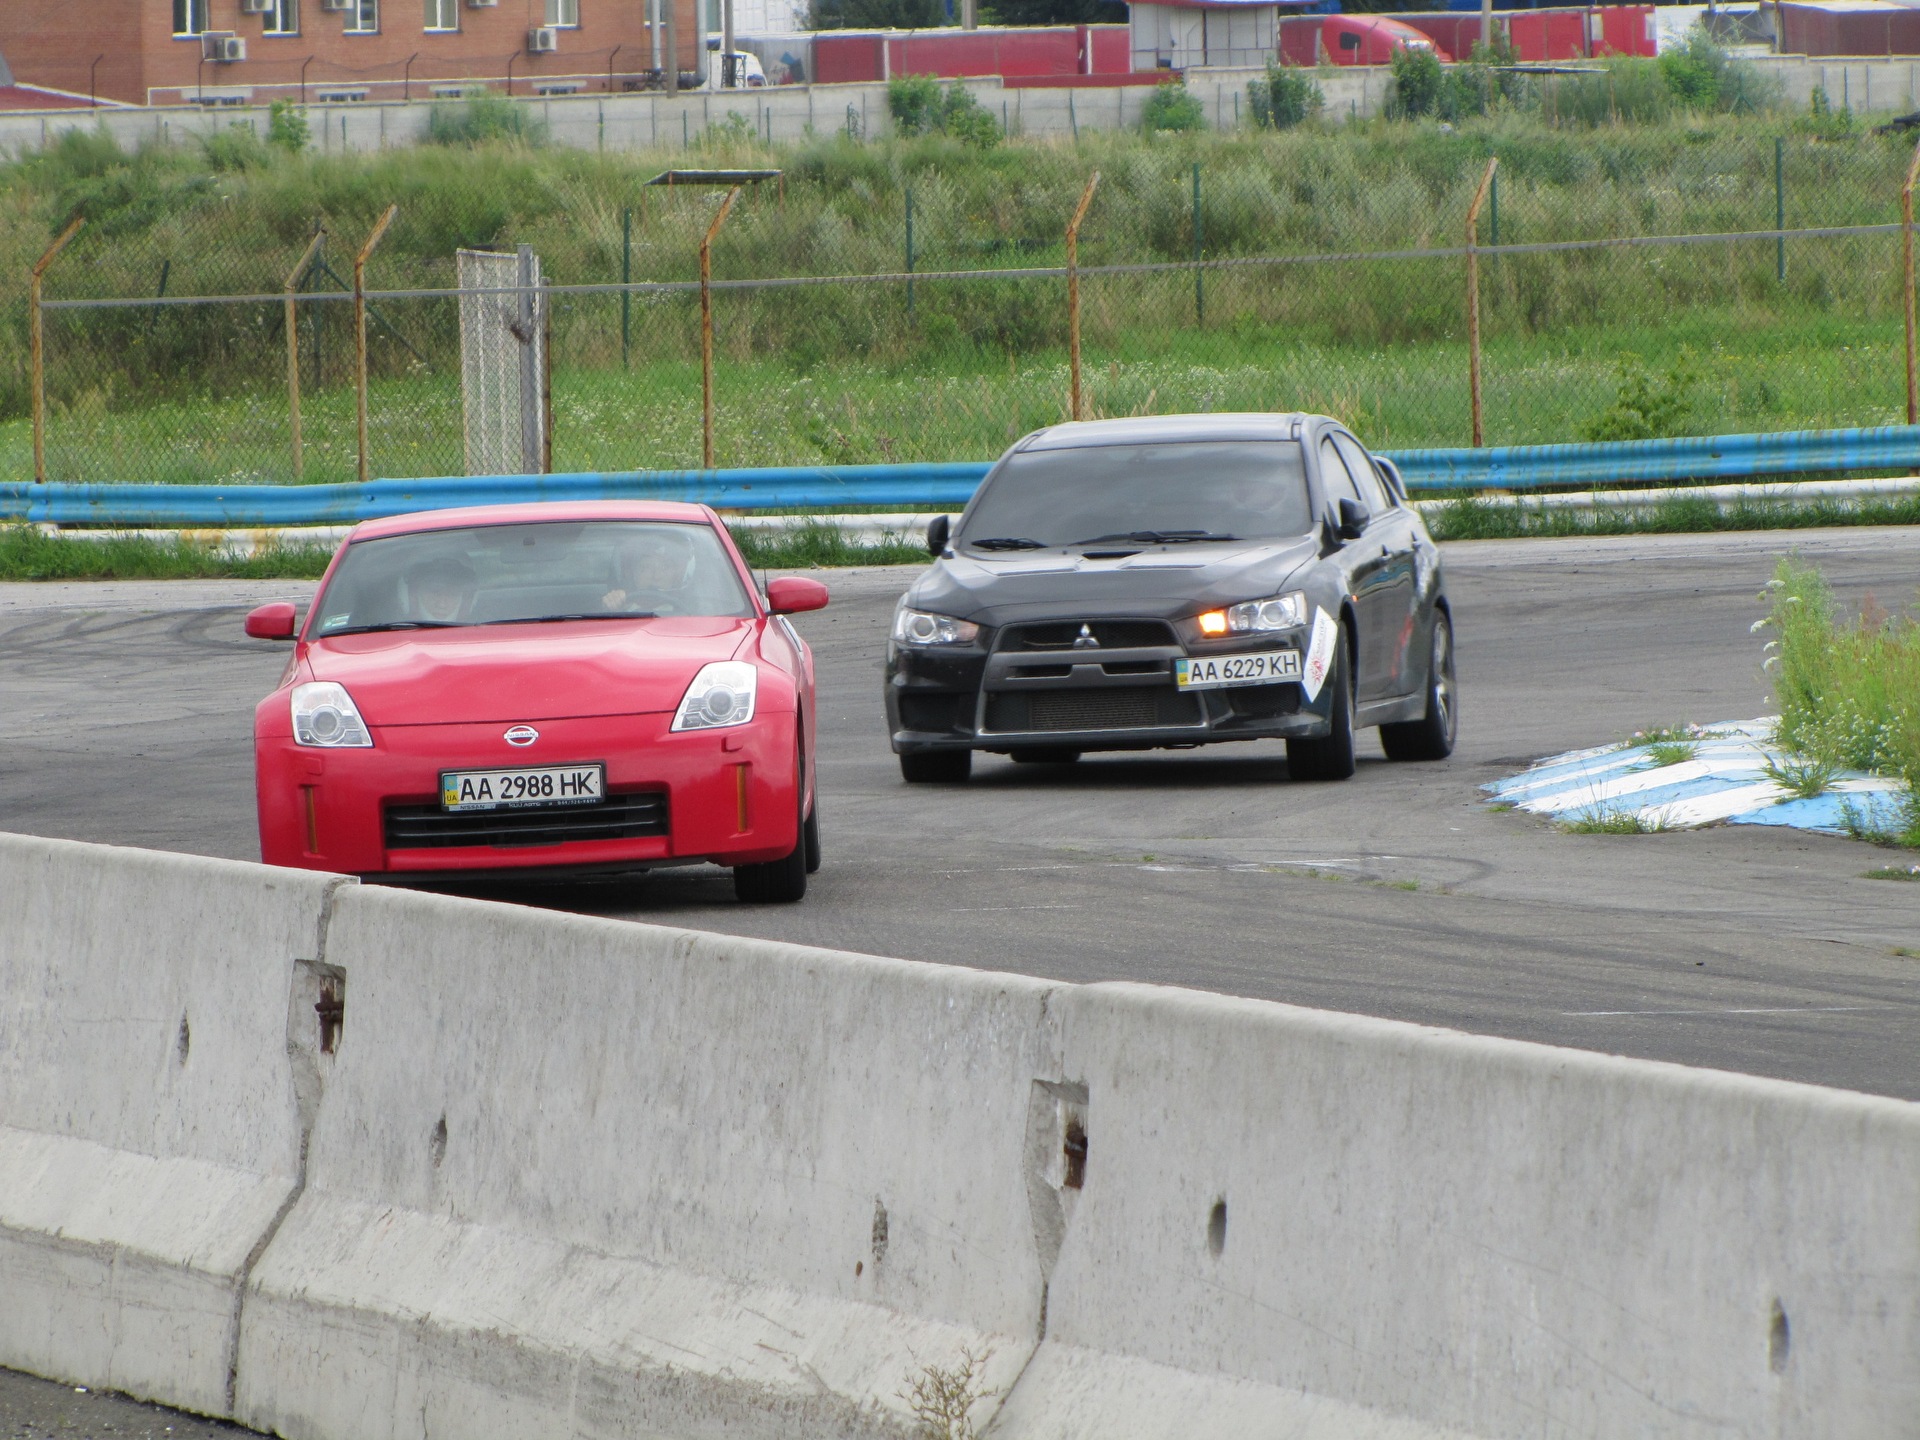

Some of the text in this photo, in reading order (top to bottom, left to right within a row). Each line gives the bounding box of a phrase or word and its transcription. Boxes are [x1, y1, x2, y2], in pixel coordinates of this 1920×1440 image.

[1191, 654, 1297, 682] AA 6229 KH
[446, 794, 458, 802] UA
[460, 771, 595, 801] AA 2988 HK
